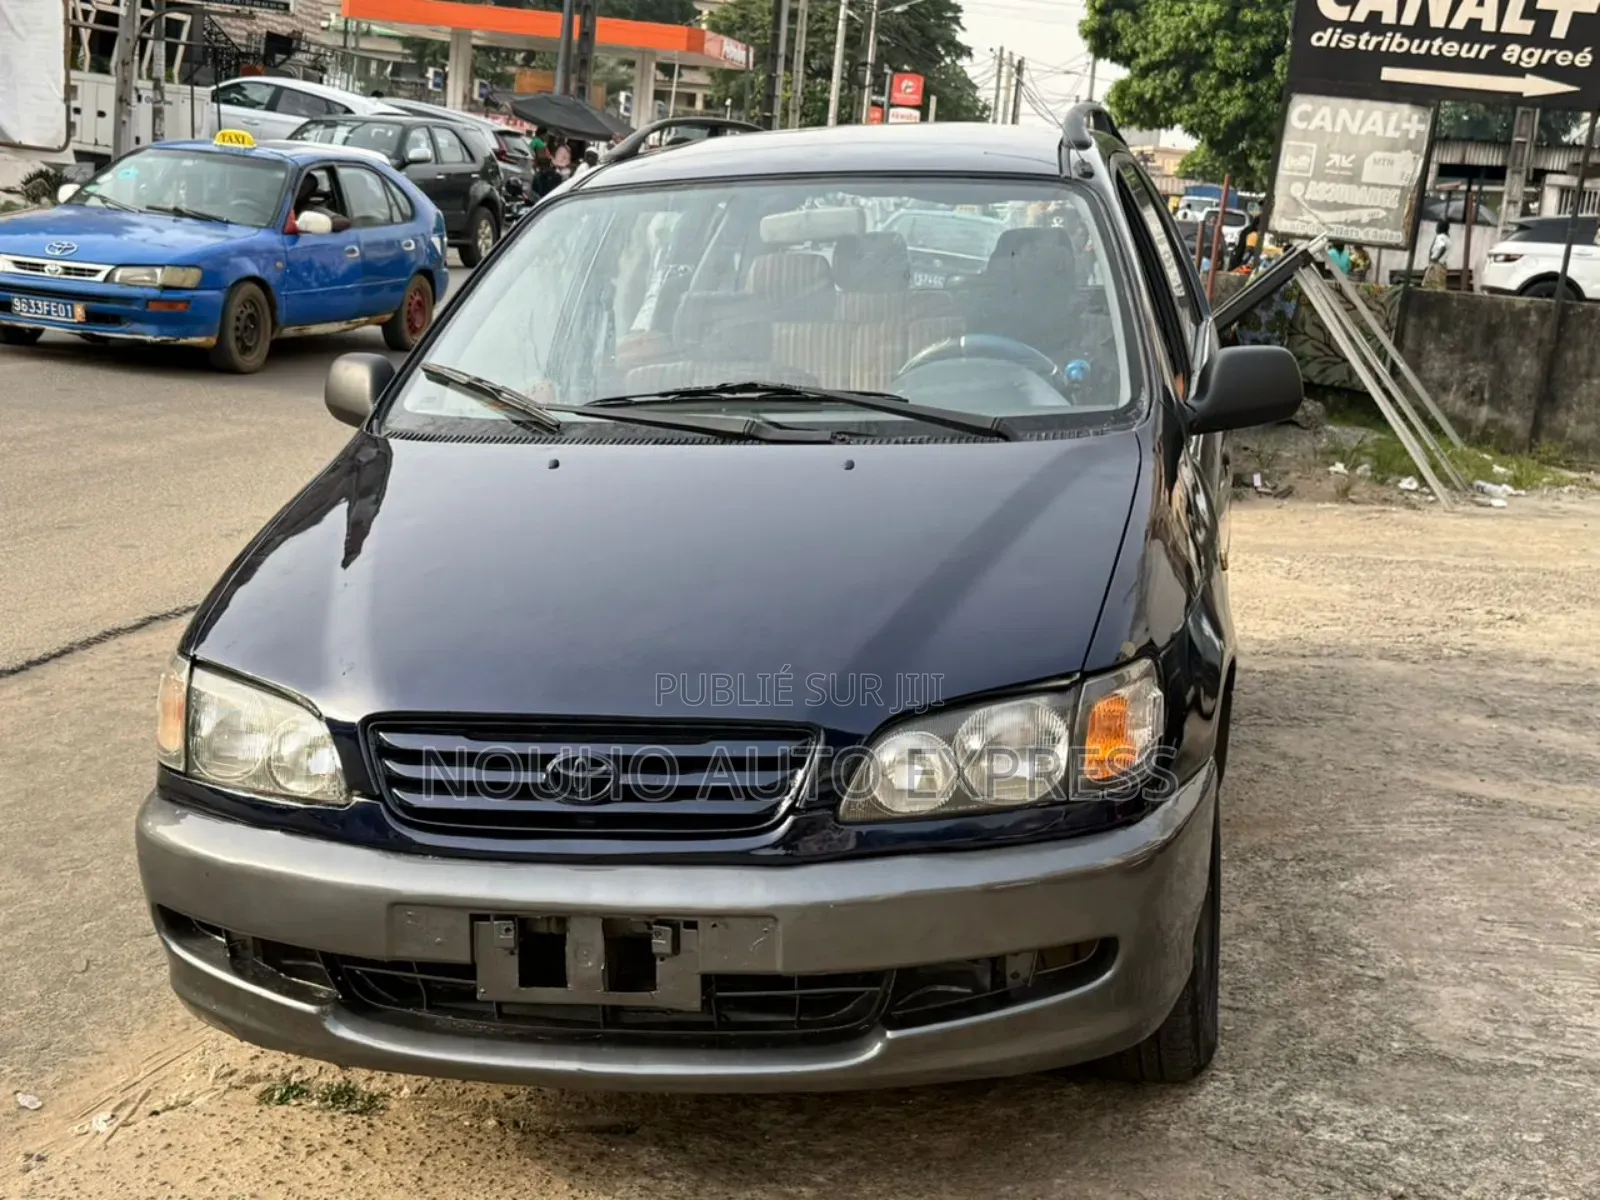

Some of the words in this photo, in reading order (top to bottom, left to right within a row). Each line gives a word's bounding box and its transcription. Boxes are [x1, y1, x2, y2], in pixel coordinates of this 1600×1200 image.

[1310, 27, 1496, 60] distributeur
[1502, 43, 1594, 68] agreé
[1290, 103, 1426, 139] CANAL+
[220, 133, 246, 145] TAXI
[13, 298, 73, 319] 9633FE01
